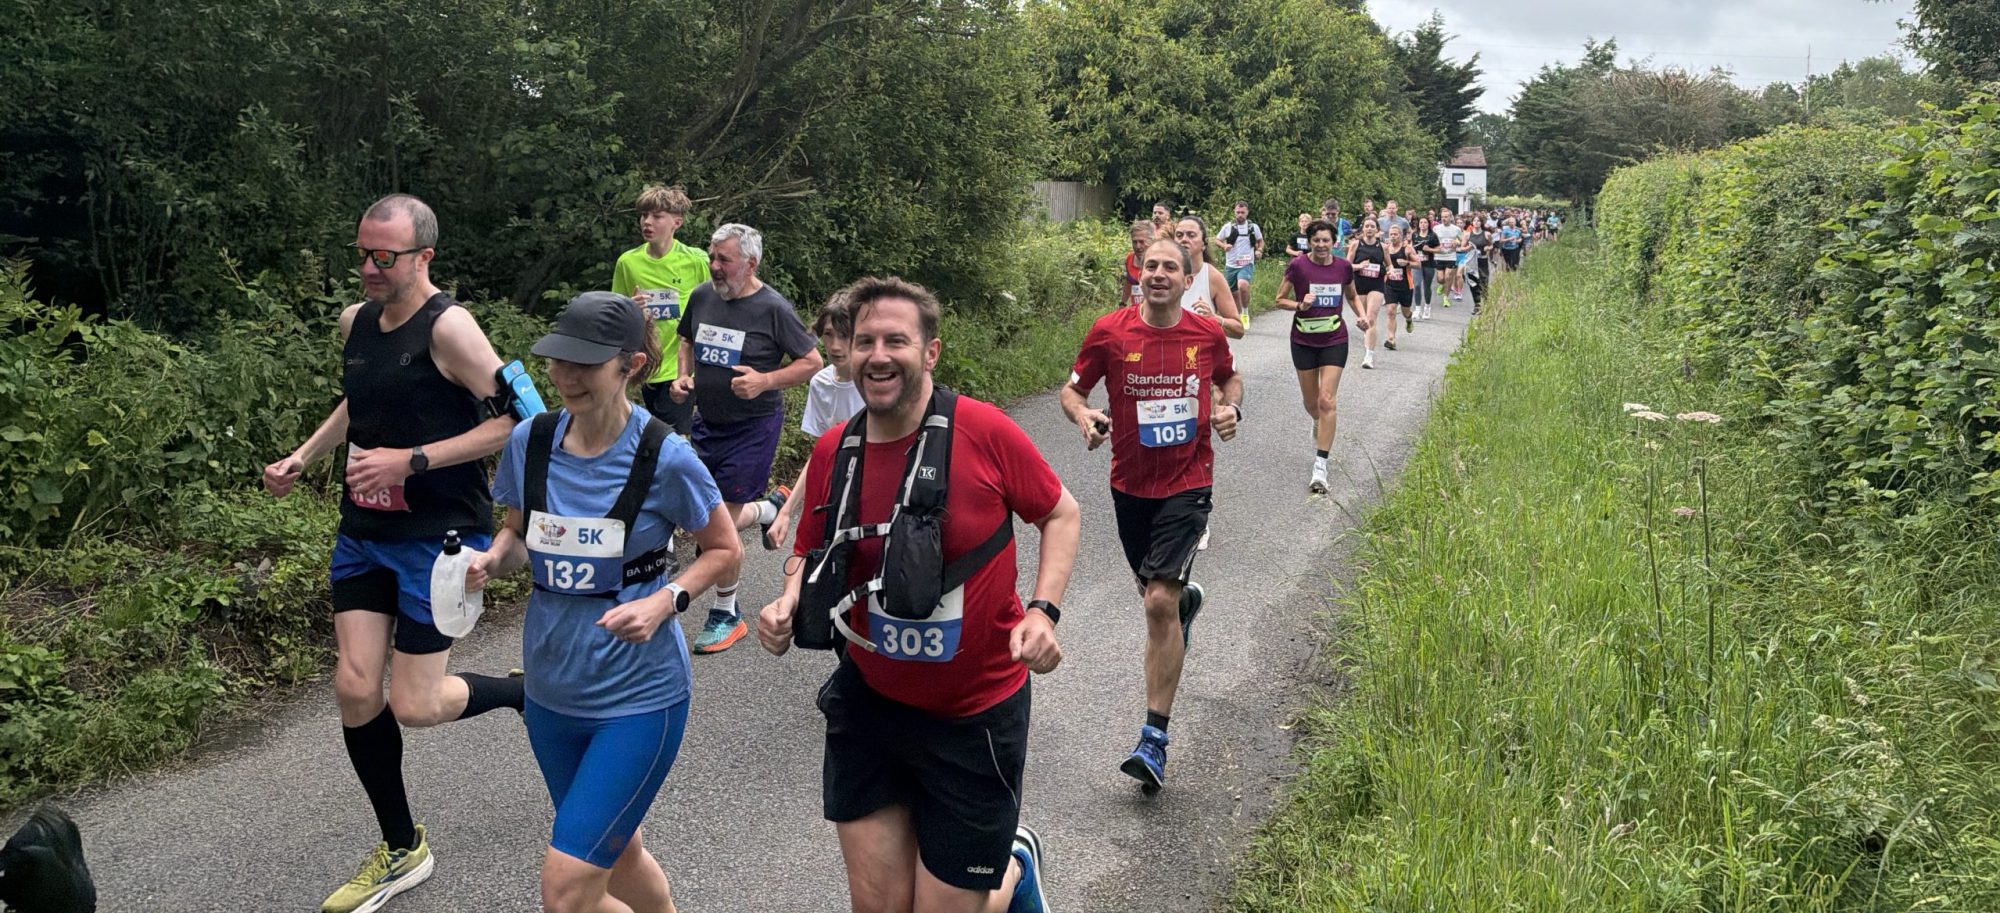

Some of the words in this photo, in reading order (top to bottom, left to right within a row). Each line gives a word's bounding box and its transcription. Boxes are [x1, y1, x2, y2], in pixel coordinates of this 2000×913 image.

[660, 292, 671, 300] 5K
[1318, 296, 1334, 306] 101
[721, 333, 735, 344] 5K
[701, 346, 730, 365] 263
[1126, 373, 1183, 385] Standard
[1123, 385, 1183, 398] Chartered
[1174, 403, 1188, 415] 5K
[1153, 423, 1187, 444] 105
[577, 527, 605, 545] 5K
[544, 559, 596, 590] 132
[882, 624, 944, 657] 303
[966, 865, 995, 874] adidas
